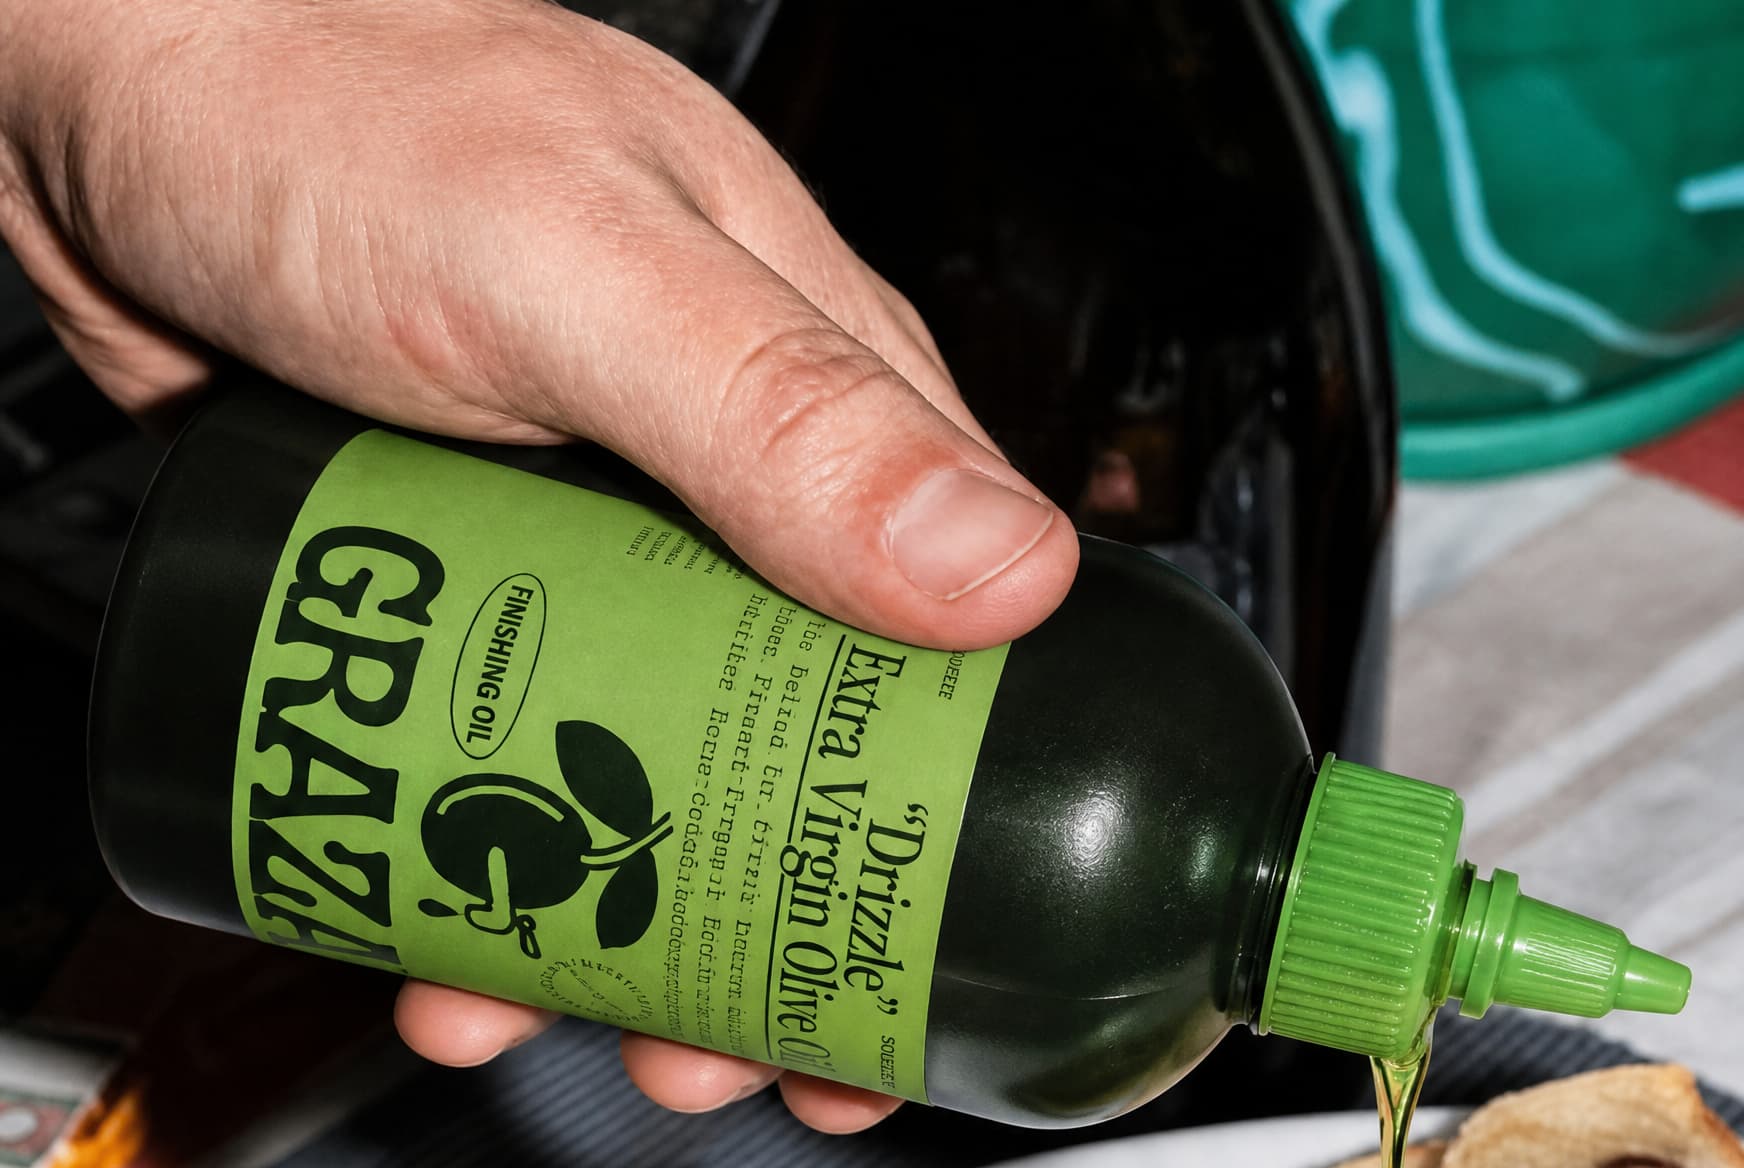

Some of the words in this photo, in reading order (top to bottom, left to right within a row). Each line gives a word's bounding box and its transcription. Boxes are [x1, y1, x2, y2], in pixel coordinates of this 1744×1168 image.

[478, 584, 535, 700] FINISHING
[249, 526, 446, 970] GRAZA
[465, 704, 497, 744] OIL
[818, 643, 907, 759] Extra
[779, 780, 868, 927] Virgin
[777, 941, 840, 1033] Olive
